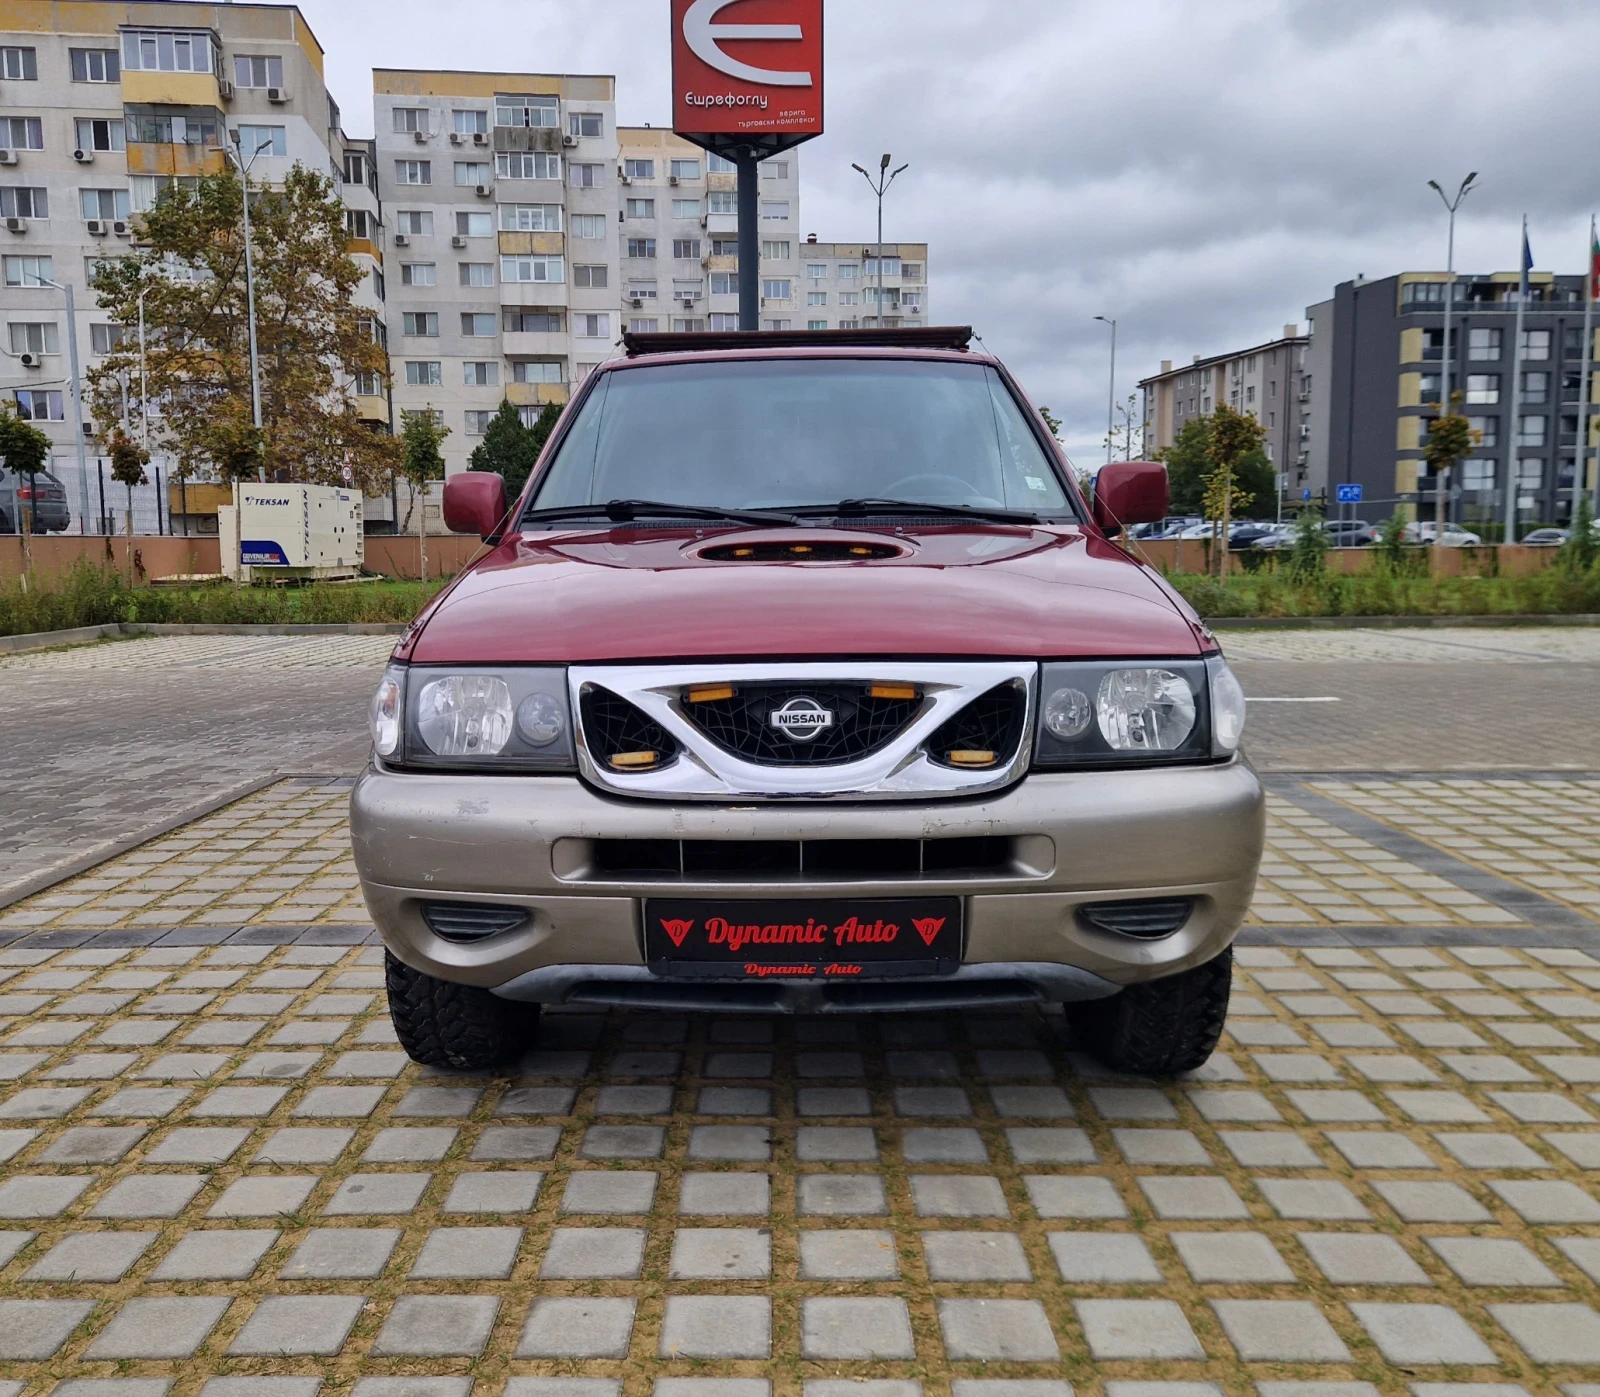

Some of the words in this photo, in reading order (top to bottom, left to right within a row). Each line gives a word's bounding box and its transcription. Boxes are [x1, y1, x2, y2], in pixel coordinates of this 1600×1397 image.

[737, 119, 775, 129] търговски
[776, 117, 816, 126] комплекси
[255, 498, 290, 506] TEKSAN
[778, 714, 826, 724] NISSAN
[705, 917, 828, 951] Dynamic
[833, 916, 900, 947] Auto
[744, 962, 817, 977] Dynamic
[823, 963, 863, 976] Auto
